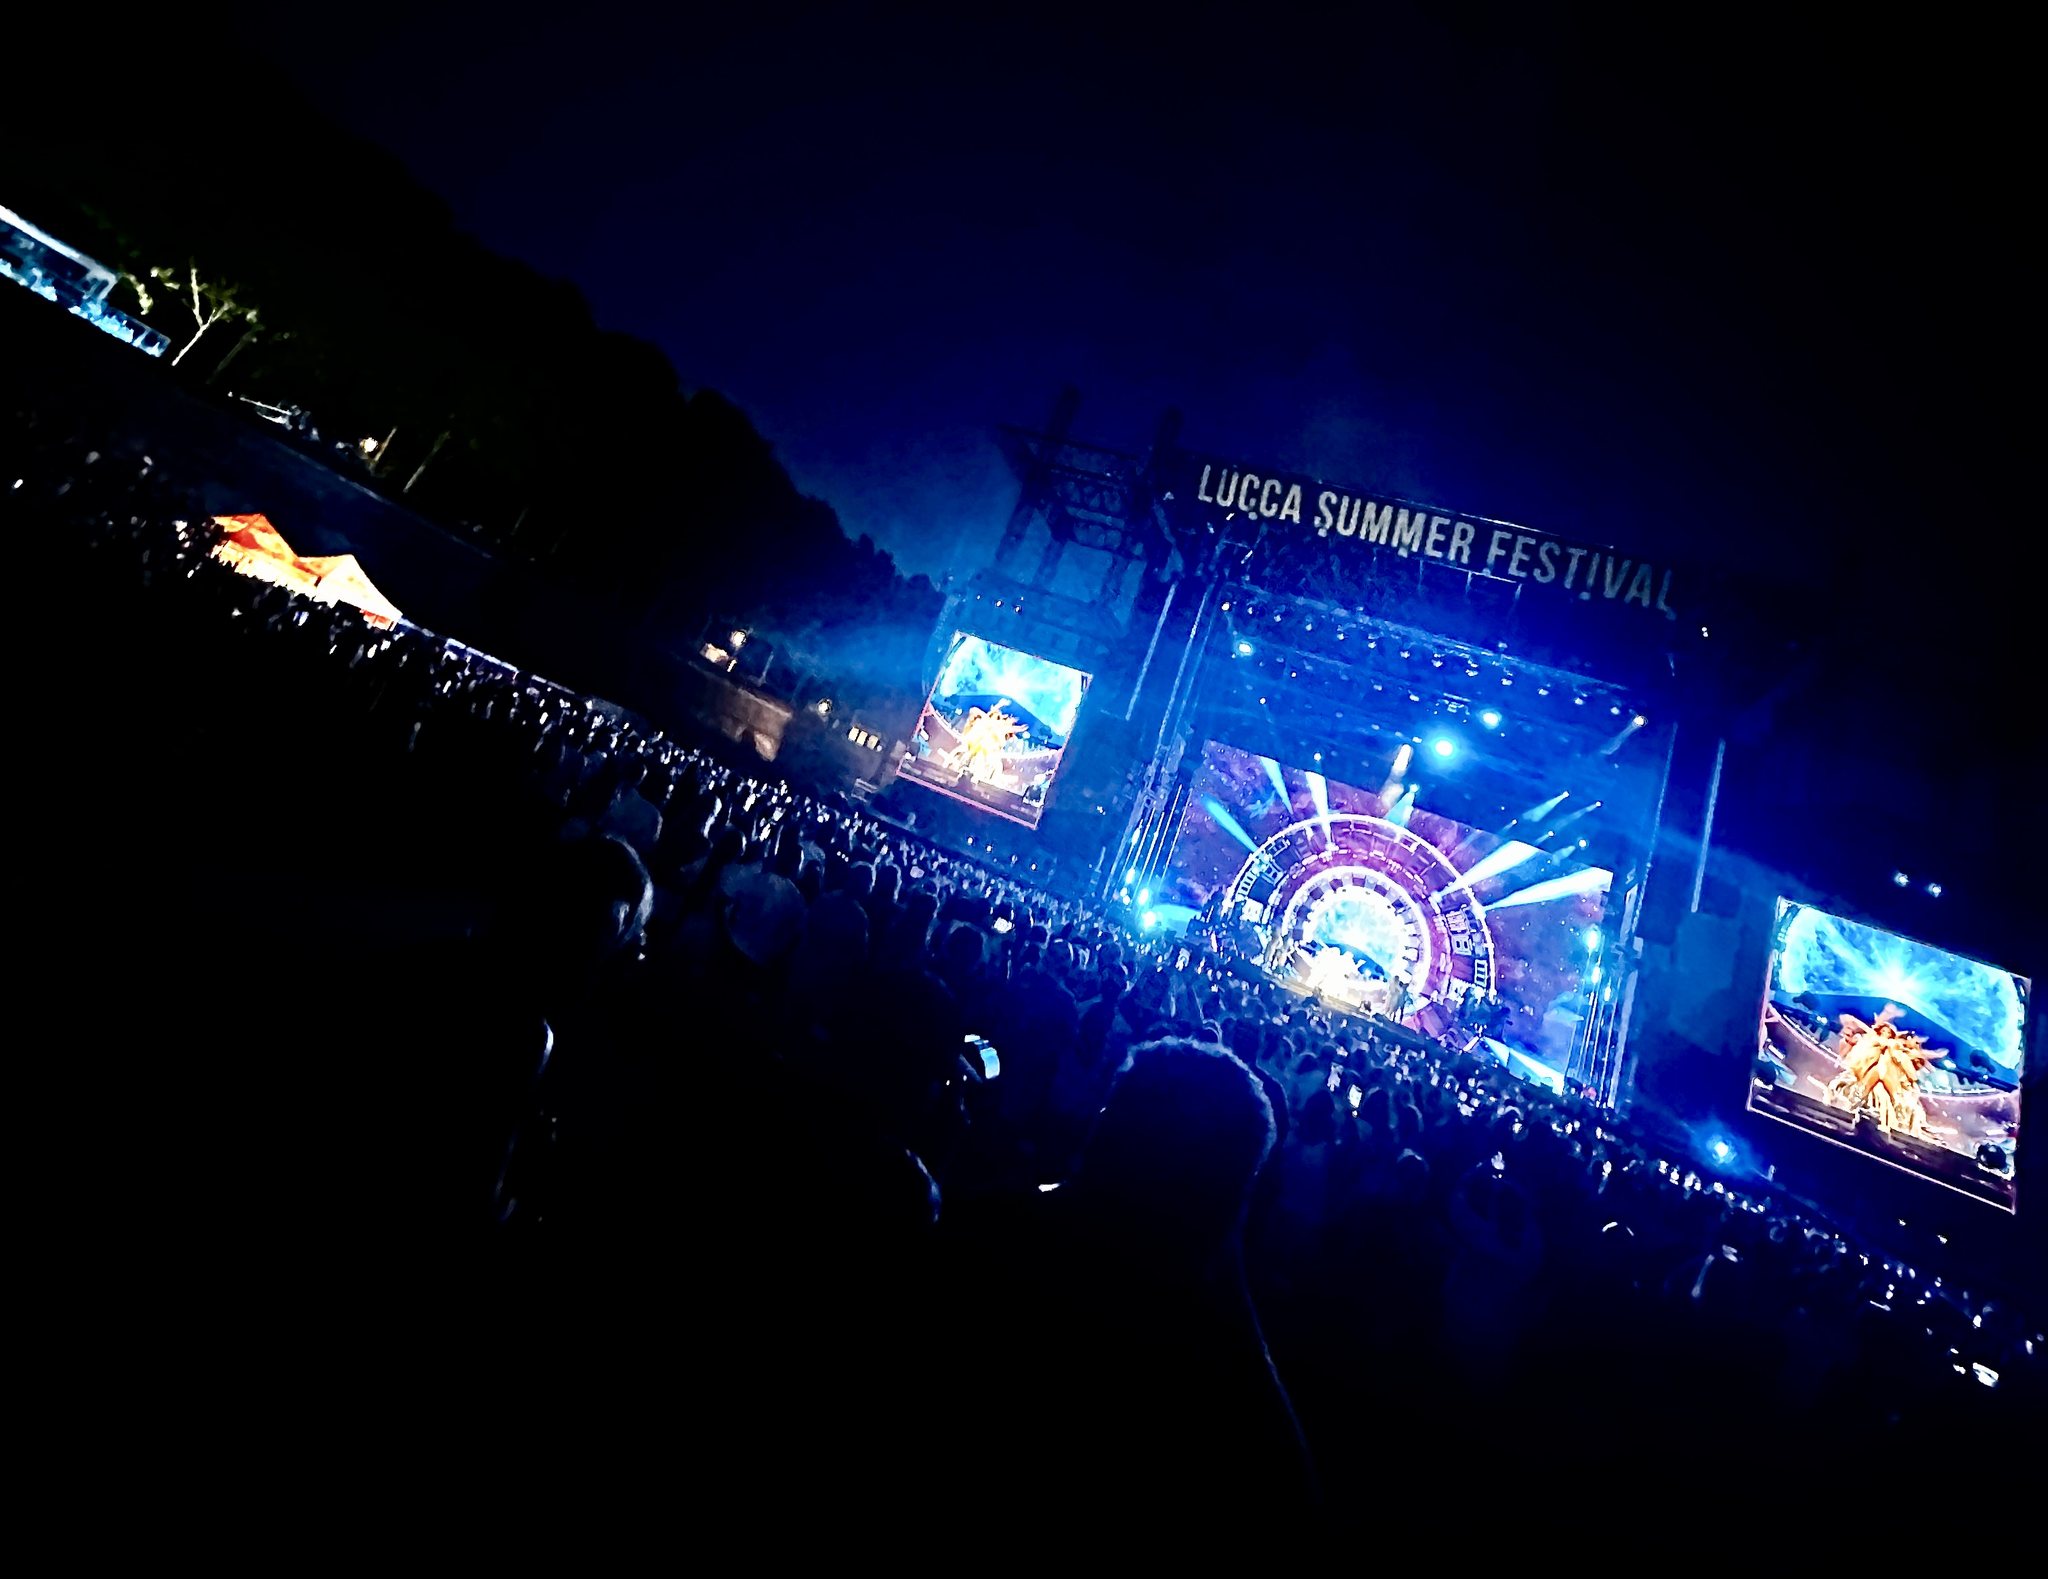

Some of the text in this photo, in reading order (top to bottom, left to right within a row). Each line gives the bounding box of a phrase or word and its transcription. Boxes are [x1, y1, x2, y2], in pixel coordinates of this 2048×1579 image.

[1197, 463, 1677, 616] LUCCA SUMMER FESTIVAL
